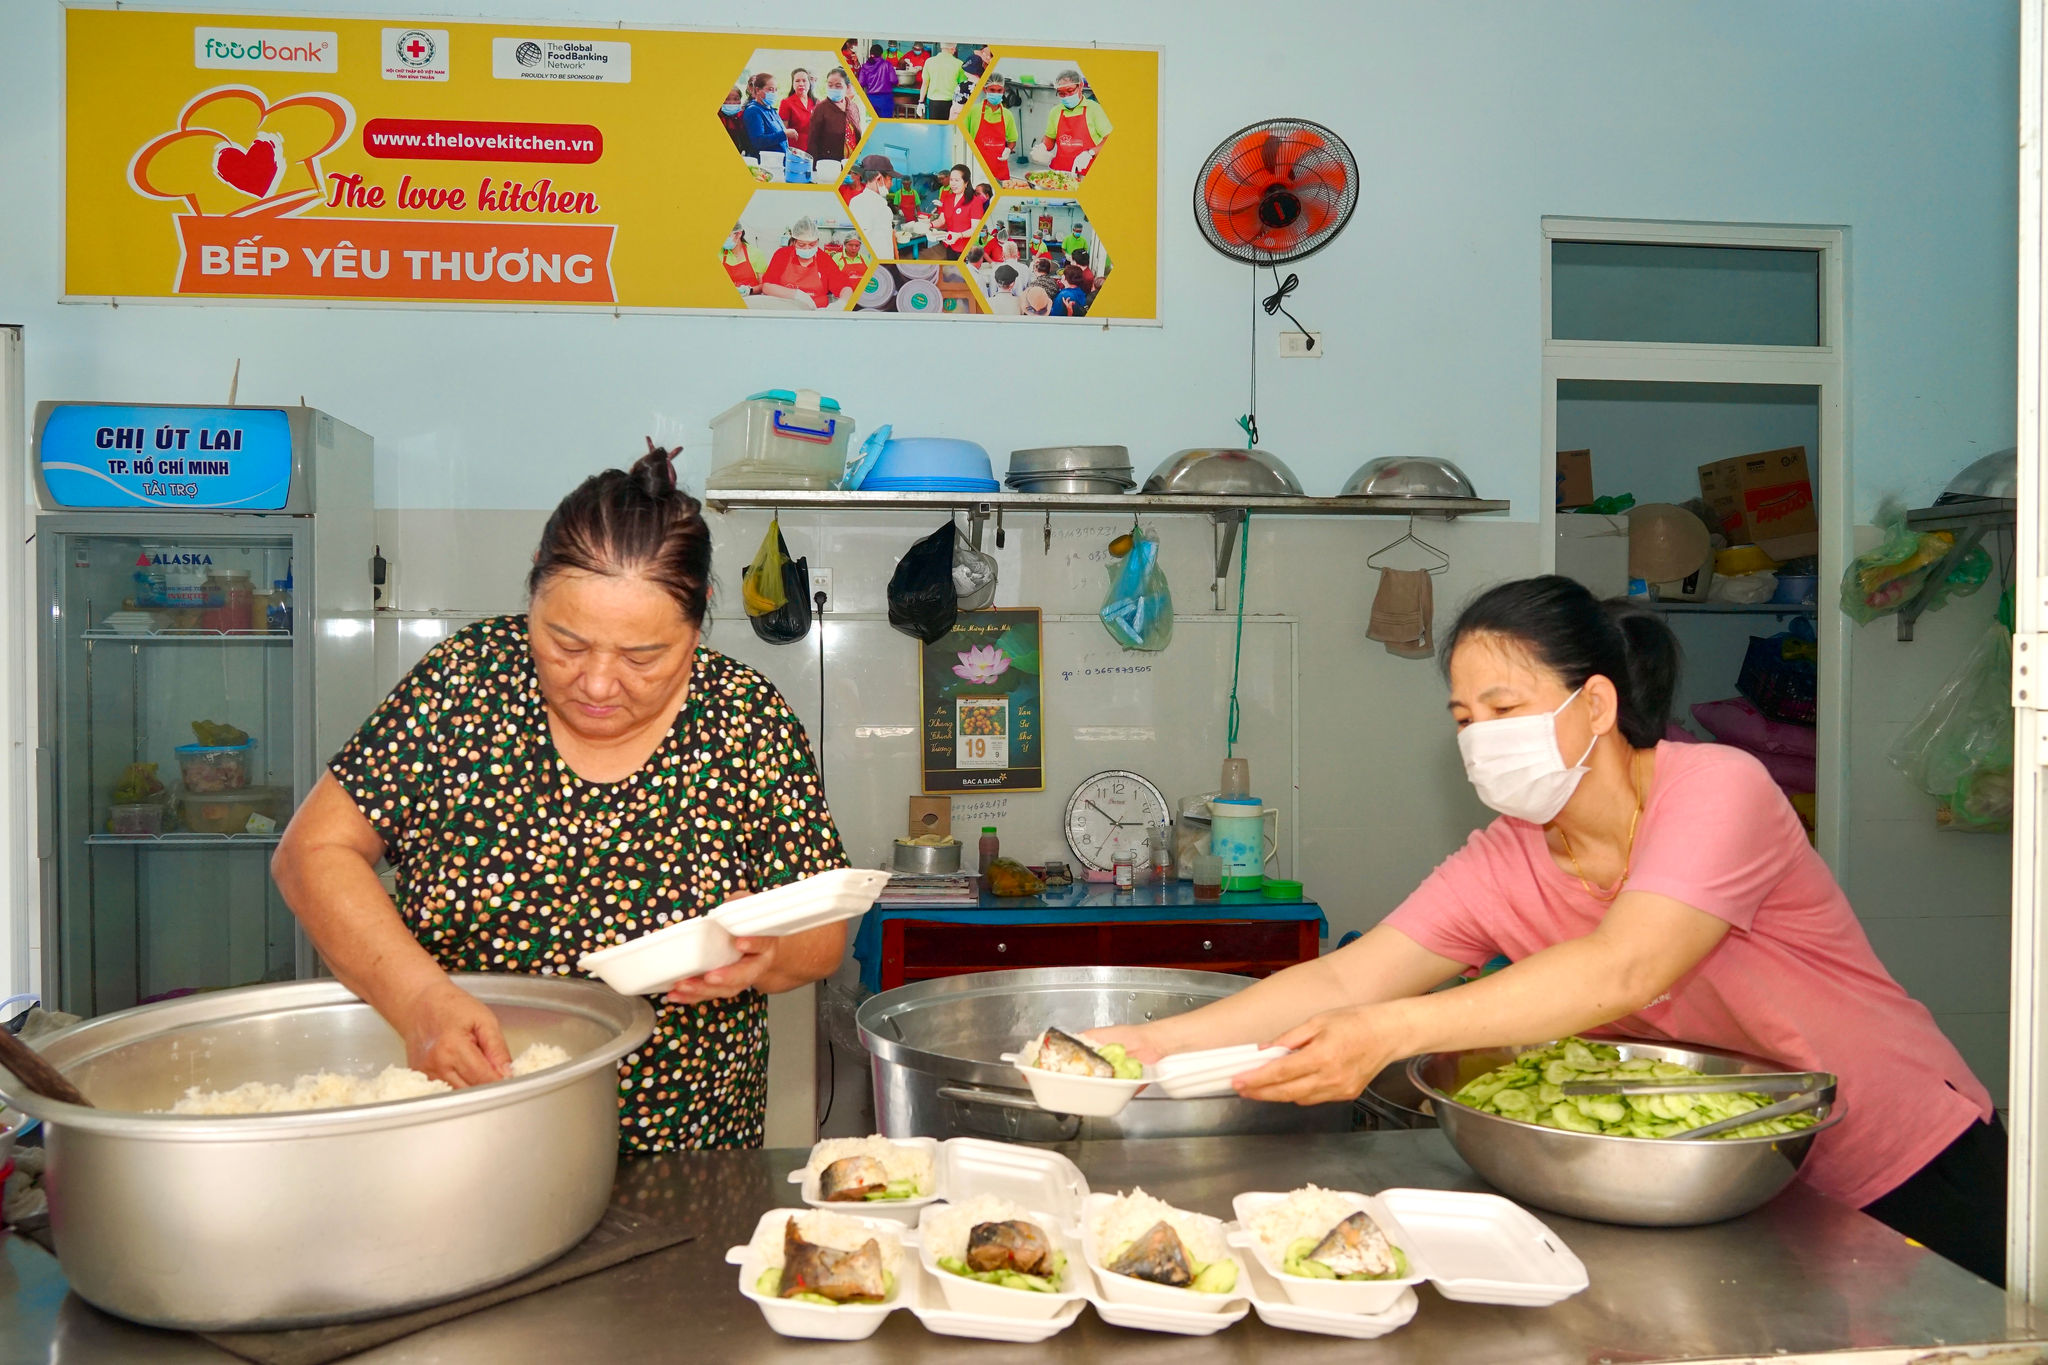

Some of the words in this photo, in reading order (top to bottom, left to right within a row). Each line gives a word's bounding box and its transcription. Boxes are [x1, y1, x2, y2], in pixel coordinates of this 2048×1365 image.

[547, 42, 563, 51] The
[563, 43, 593, 52] Global
[547, 51, 608, 63] FoodBanking
[372, 132, 594, 151] www.thelovekitchen.vn
[327, 172, 386, 209] The
[397, 175, 467, 210] love
[477, 177, 600, 214] kitchen
[201, 235, 290, 276] BẾP
[302, 240, 390, 279] YÊU
[403, 246, 593, 285] THƯƠNG
[96, 427, 145, 453] CHỊ
[155, 425, 190, 450] ÚT
[199, 429, 243, 451] LAI
[108, 459, 129, 474] TP.
[133, 456, 154, 475] HỒ
[158, 457, 184, 475] CHÍ
[188, 461, 229, 475] MINH
[143, 480, 166, 496] TÀI
[168, 482, 198, 499] TRỢ
[152, 553, 213, 565] ALASKA
[965, 738, 986, 758] 19
[1097, 788, 1106, 799] 11
[1112, 783, 1125, 794] 12
[1134, 790, 1137, 800] 1
[1084, 799, 1096, 810] 10
[1142, 802, 1151, 814] 2
[1078, 816, 1086, 827] 9
[1148, 820, 1156, 828] 3
[1082, 834, 1091, 845] 8
[1141, 837, 1149, 848] 4
[1095, 846, 1102, 857] 7
[1130, 848, 1137, 860] 5
